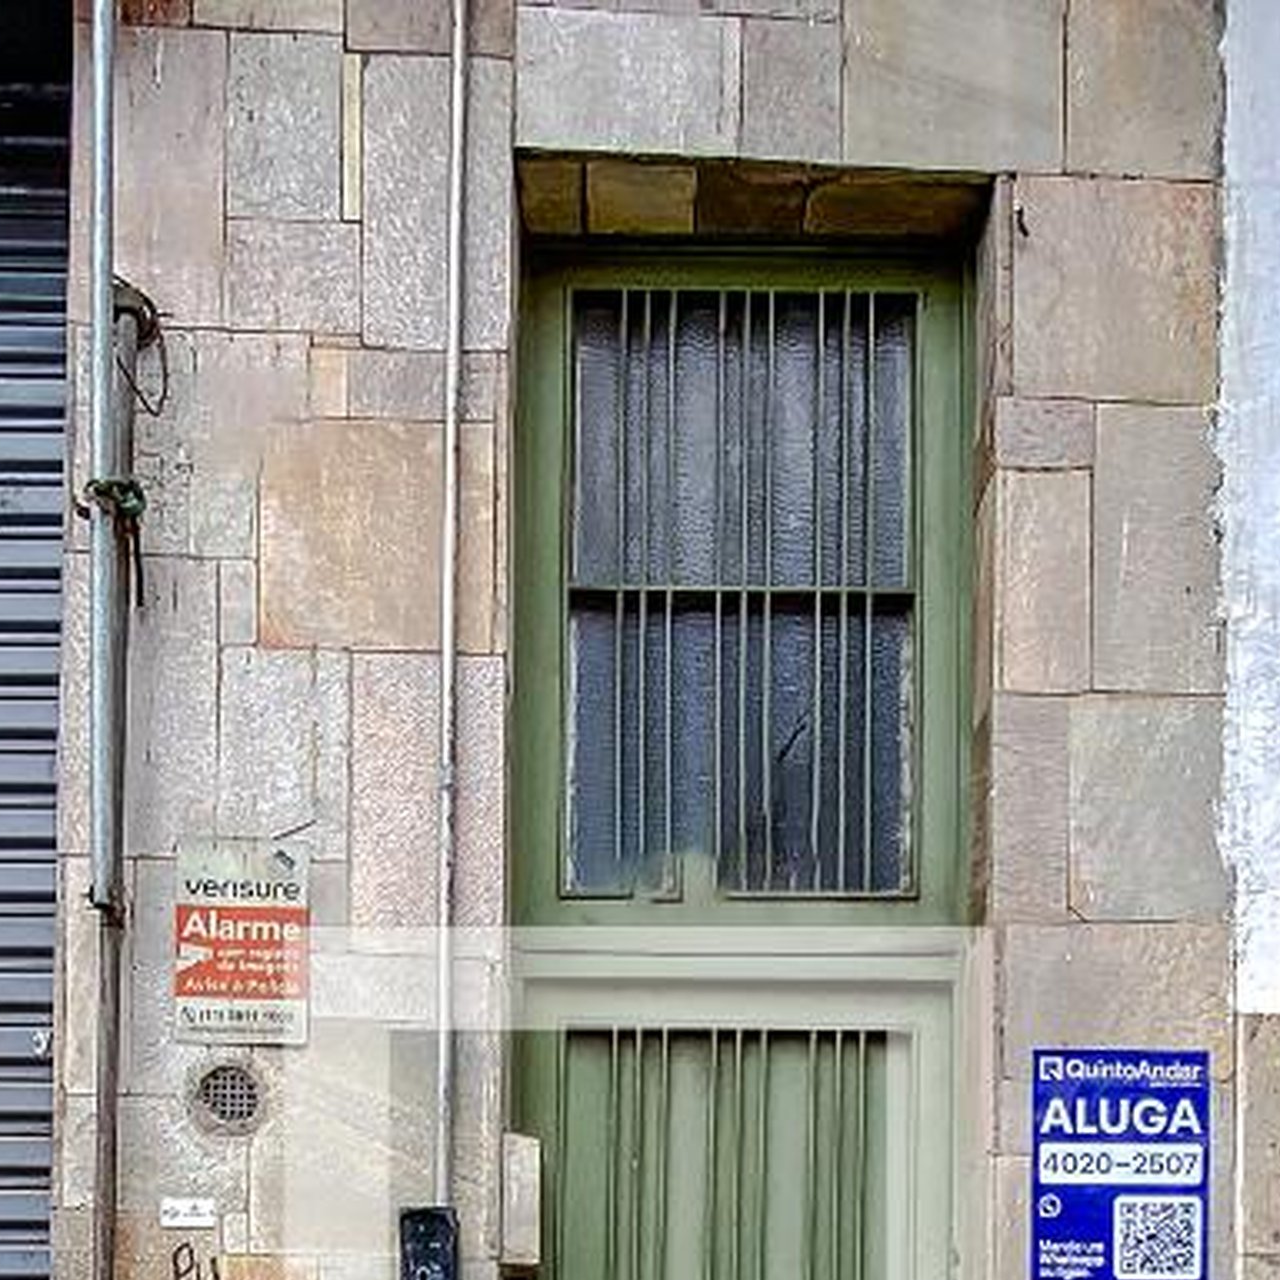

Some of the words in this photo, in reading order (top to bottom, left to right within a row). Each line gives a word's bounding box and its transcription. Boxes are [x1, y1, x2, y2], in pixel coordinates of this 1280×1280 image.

[181, 909, 301, 942] Alarme
[1066, 1058, 1203, 1081] QuintoAndar
[1039, 1098, 1202, 1135] ALUGA
[1042, 1152, 1199, 1175] 4020-2507
